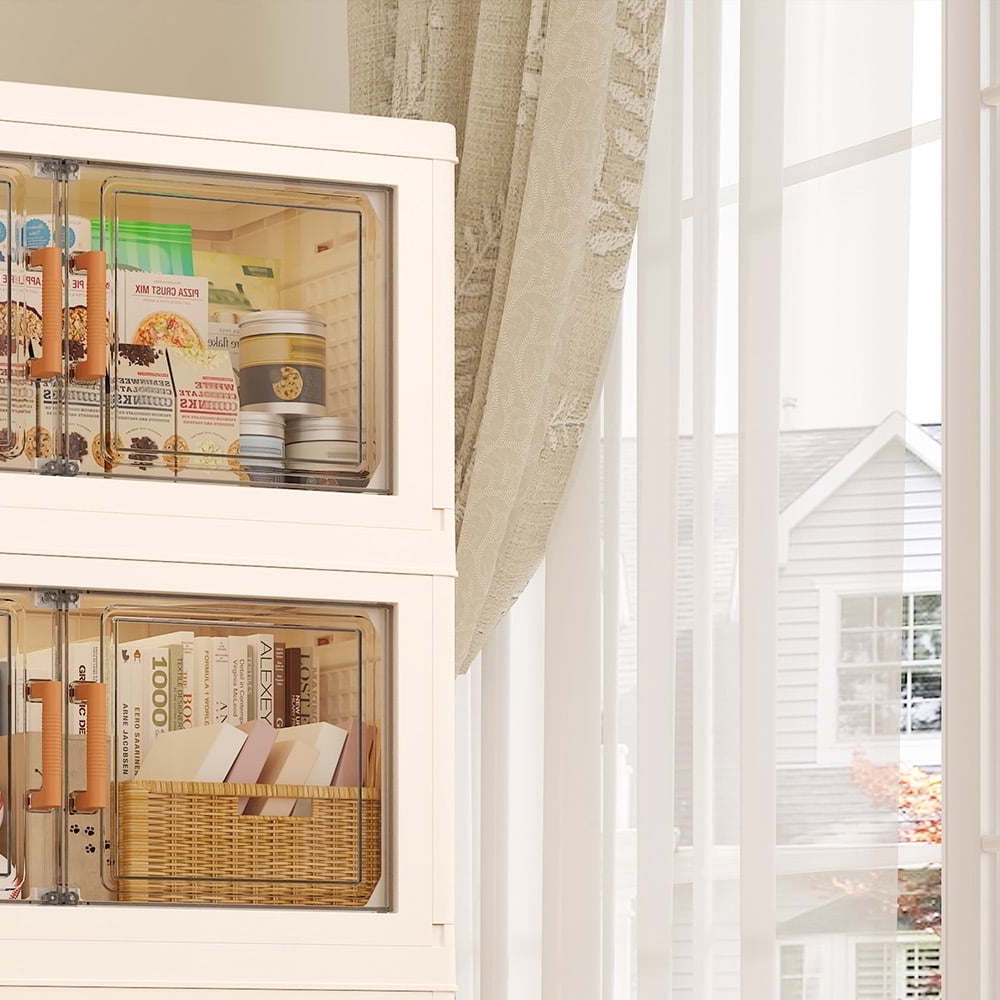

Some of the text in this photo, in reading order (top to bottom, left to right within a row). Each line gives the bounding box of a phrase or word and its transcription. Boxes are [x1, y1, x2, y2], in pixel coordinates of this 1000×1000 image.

[152, 656, 167, 727] 1000
[239, 681, 245, 689] in
[260, 641, 272, 726] ALEXEY
